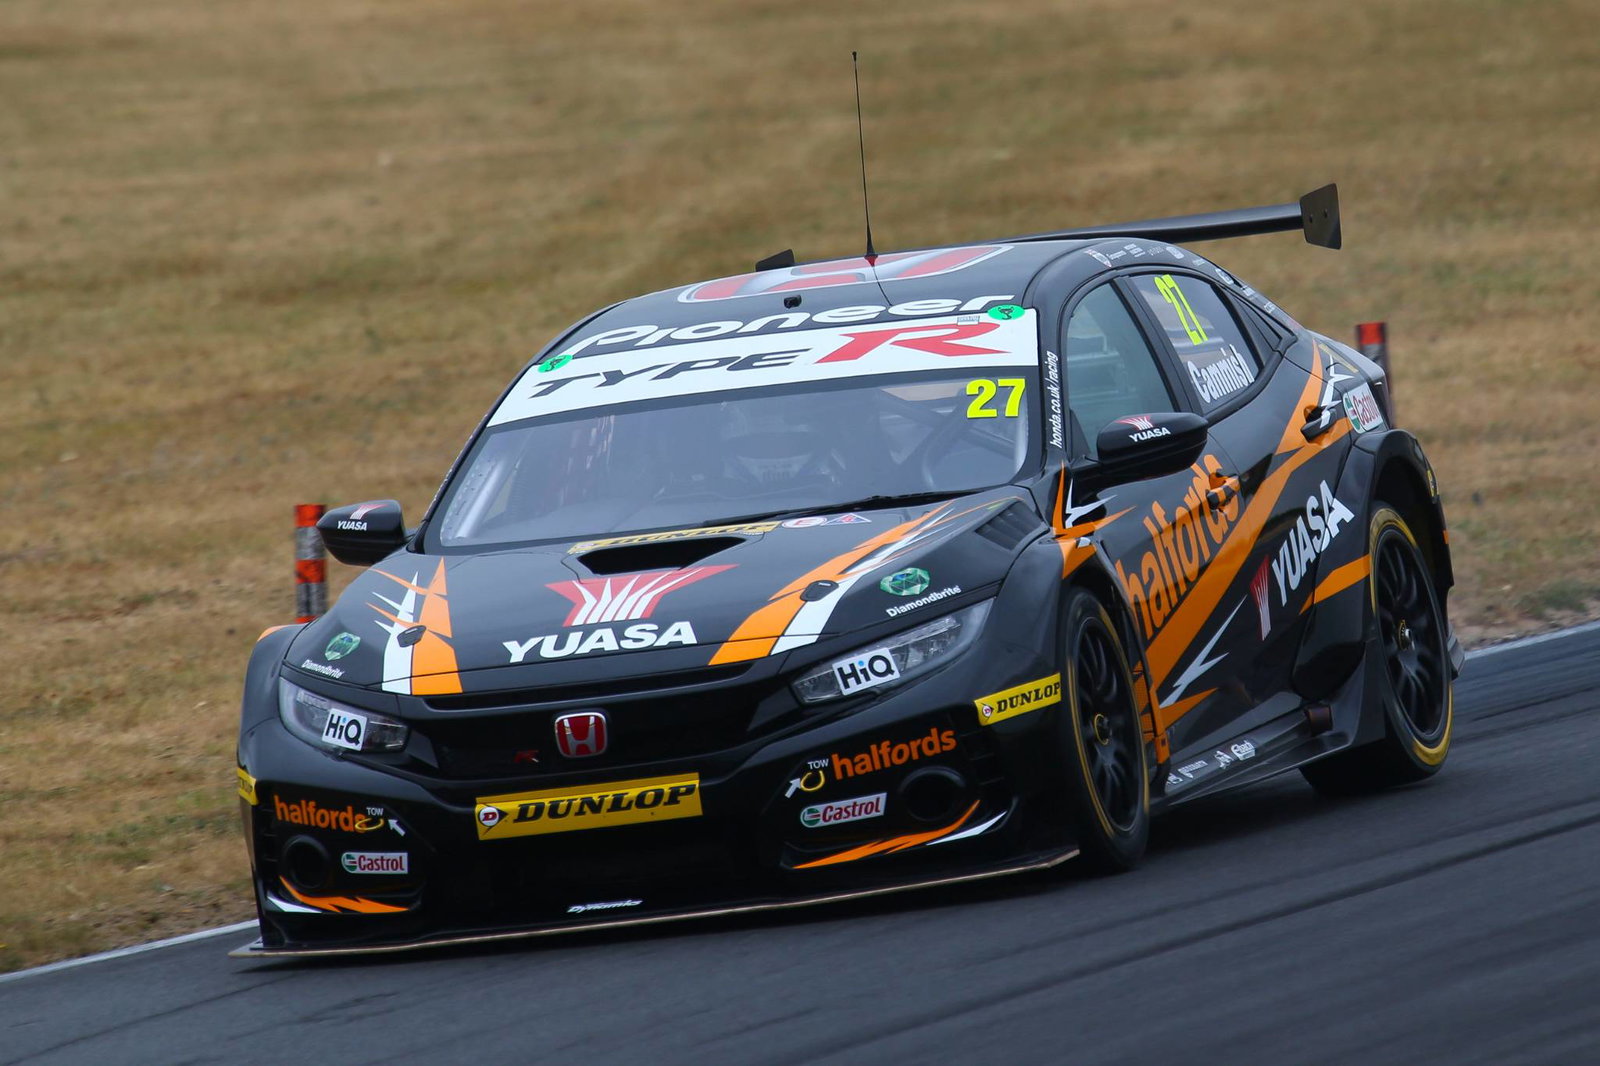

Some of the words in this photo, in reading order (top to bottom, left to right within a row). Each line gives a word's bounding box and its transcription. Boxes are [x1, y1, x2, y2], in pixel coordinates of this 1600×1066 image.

[1154, 274, 1208, 346] 27
[531, 348, 811, 399] TYPE
[814, 322, 1012, 364] R
[1187, 343, 1255, 404] Cammish
[965, 377, 1027, 419] 27
[1045, 350, 1063, 449] honda.co.uk/racing
[1128, 427, 1172, 443] YUASA
[336, 520, 368, 531] YUASA
[1271, 479, 1355, 608] YUASA
[886, 584, 962, 618] Diamondbrite
[502, 620, 698, 663] YUASA
[836, 654, 895, 690] HiQ
[995, 683, 1063, 714] DUNLOP
[325, 714, 361, 746] HiQ
[807, 758, 829, 770] TOW
[830, 727, 958, 781] halfords
[366, 806, 384, 816] TOW
[512, 783, 699, 824] DUNLOP
[820, 797, 881, 824] Castrol
[357, 855, 405, 872] Castrol
